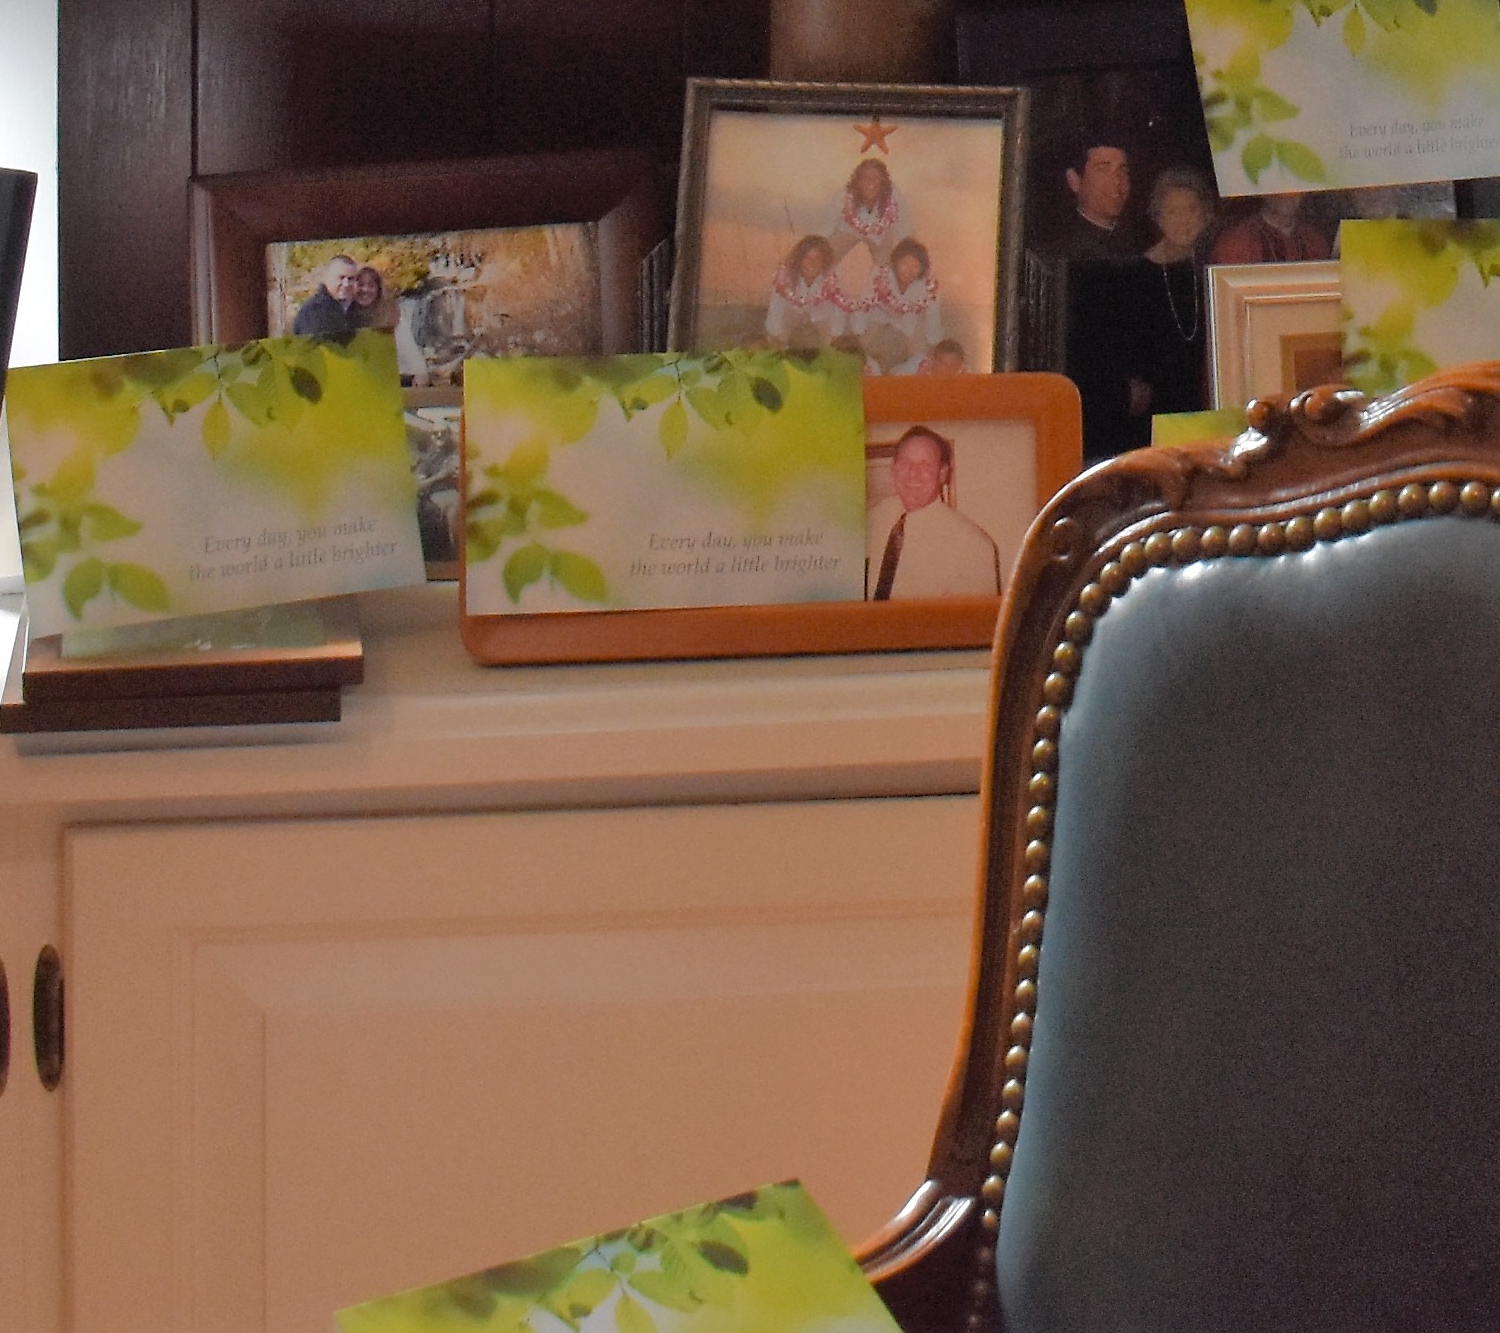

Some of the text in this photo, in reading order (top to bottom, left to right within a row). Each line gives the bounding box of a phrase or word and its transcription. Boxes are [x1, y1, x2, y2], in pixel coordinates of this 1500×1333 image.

[201, 513, 378, 558] Every day, you make
[648, 527, 823, 555] Every day, you make
[187, 561, 215, 580] the
[219, 554, 268, 576] world
[288, 546, 327, 567] little
[330, 537, 399, 566] brighter
[629, 558, 655, 576] the
[660, 557, 710, 575] world
[730, 555, 766, 572] little
[773, 553, 841, 576] brighter
